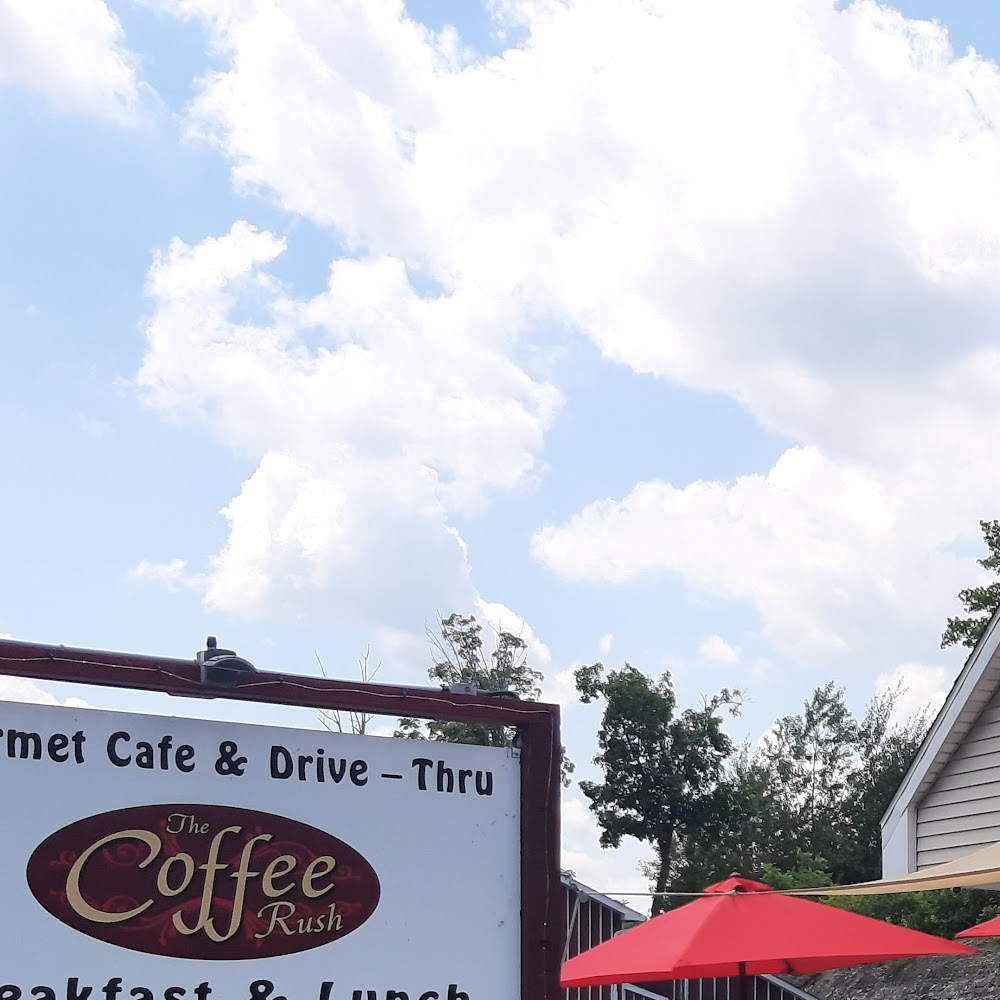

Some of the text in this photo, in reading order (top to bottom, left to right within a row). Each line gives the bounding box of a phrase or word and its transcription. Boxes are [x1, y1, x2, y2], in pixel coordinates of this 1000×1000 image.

[0, 729, 86, 765] met
[106, 731, 196, 773] Cafe
[215, 740, 248, 776] &
[270, 745, 368, 786] Drive
[411, 758, 493, 796] Thru
[165, 812, 210, 834] The
[65, 825, 336, 942] Coffee
[254, 901, 344, 939] Rush
